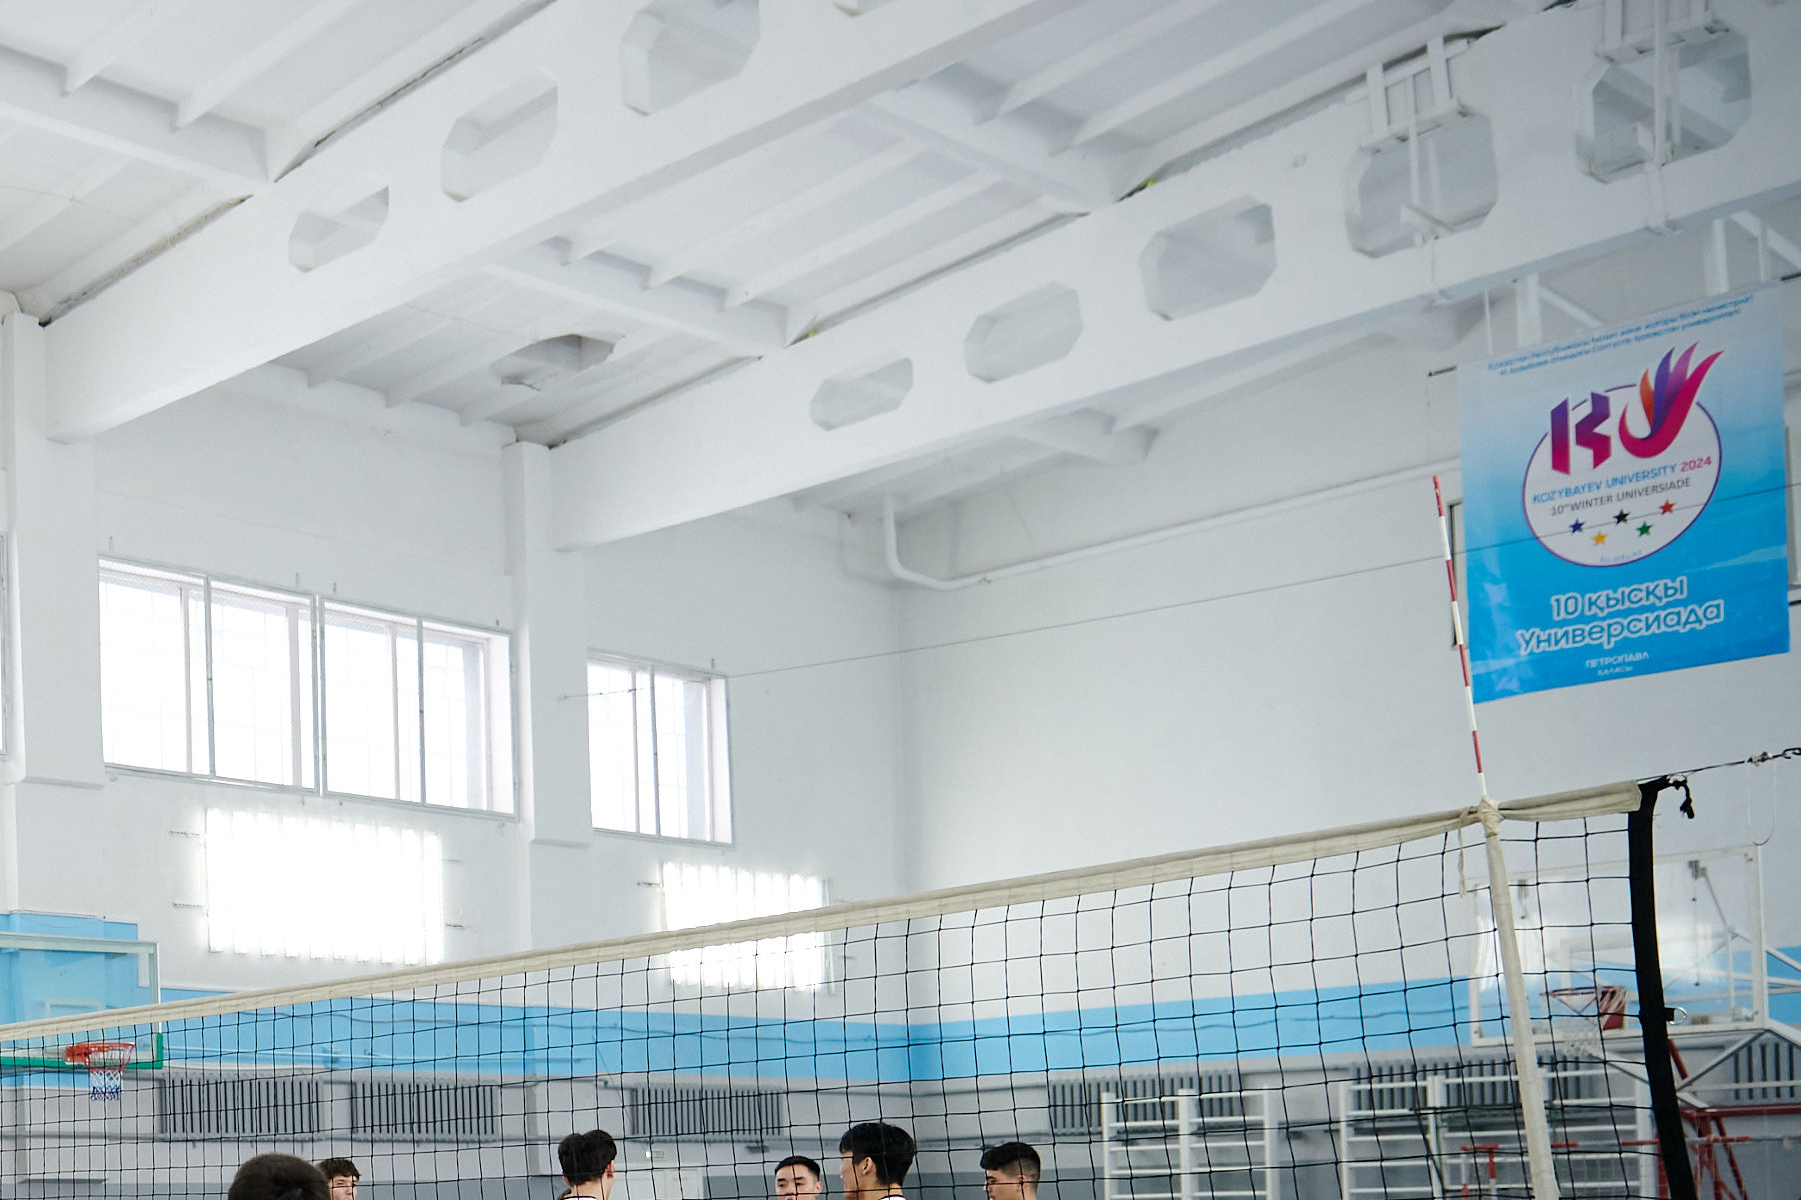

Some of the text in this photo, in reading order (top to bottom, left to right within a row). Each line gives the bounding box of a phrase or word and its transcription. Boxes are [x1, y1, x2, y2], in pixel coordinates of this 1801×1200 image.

[1532, 456, 1712, 504] KOZYBAYEV UNIVERSITY 2024
[1570, 492, 1614, 512] WINTER
[1617, 477, 1691, 502] UNIVERSIADE
[1552, 592, 1582, 620] 10
[1517, 599, 1724, 655] Универсиада
